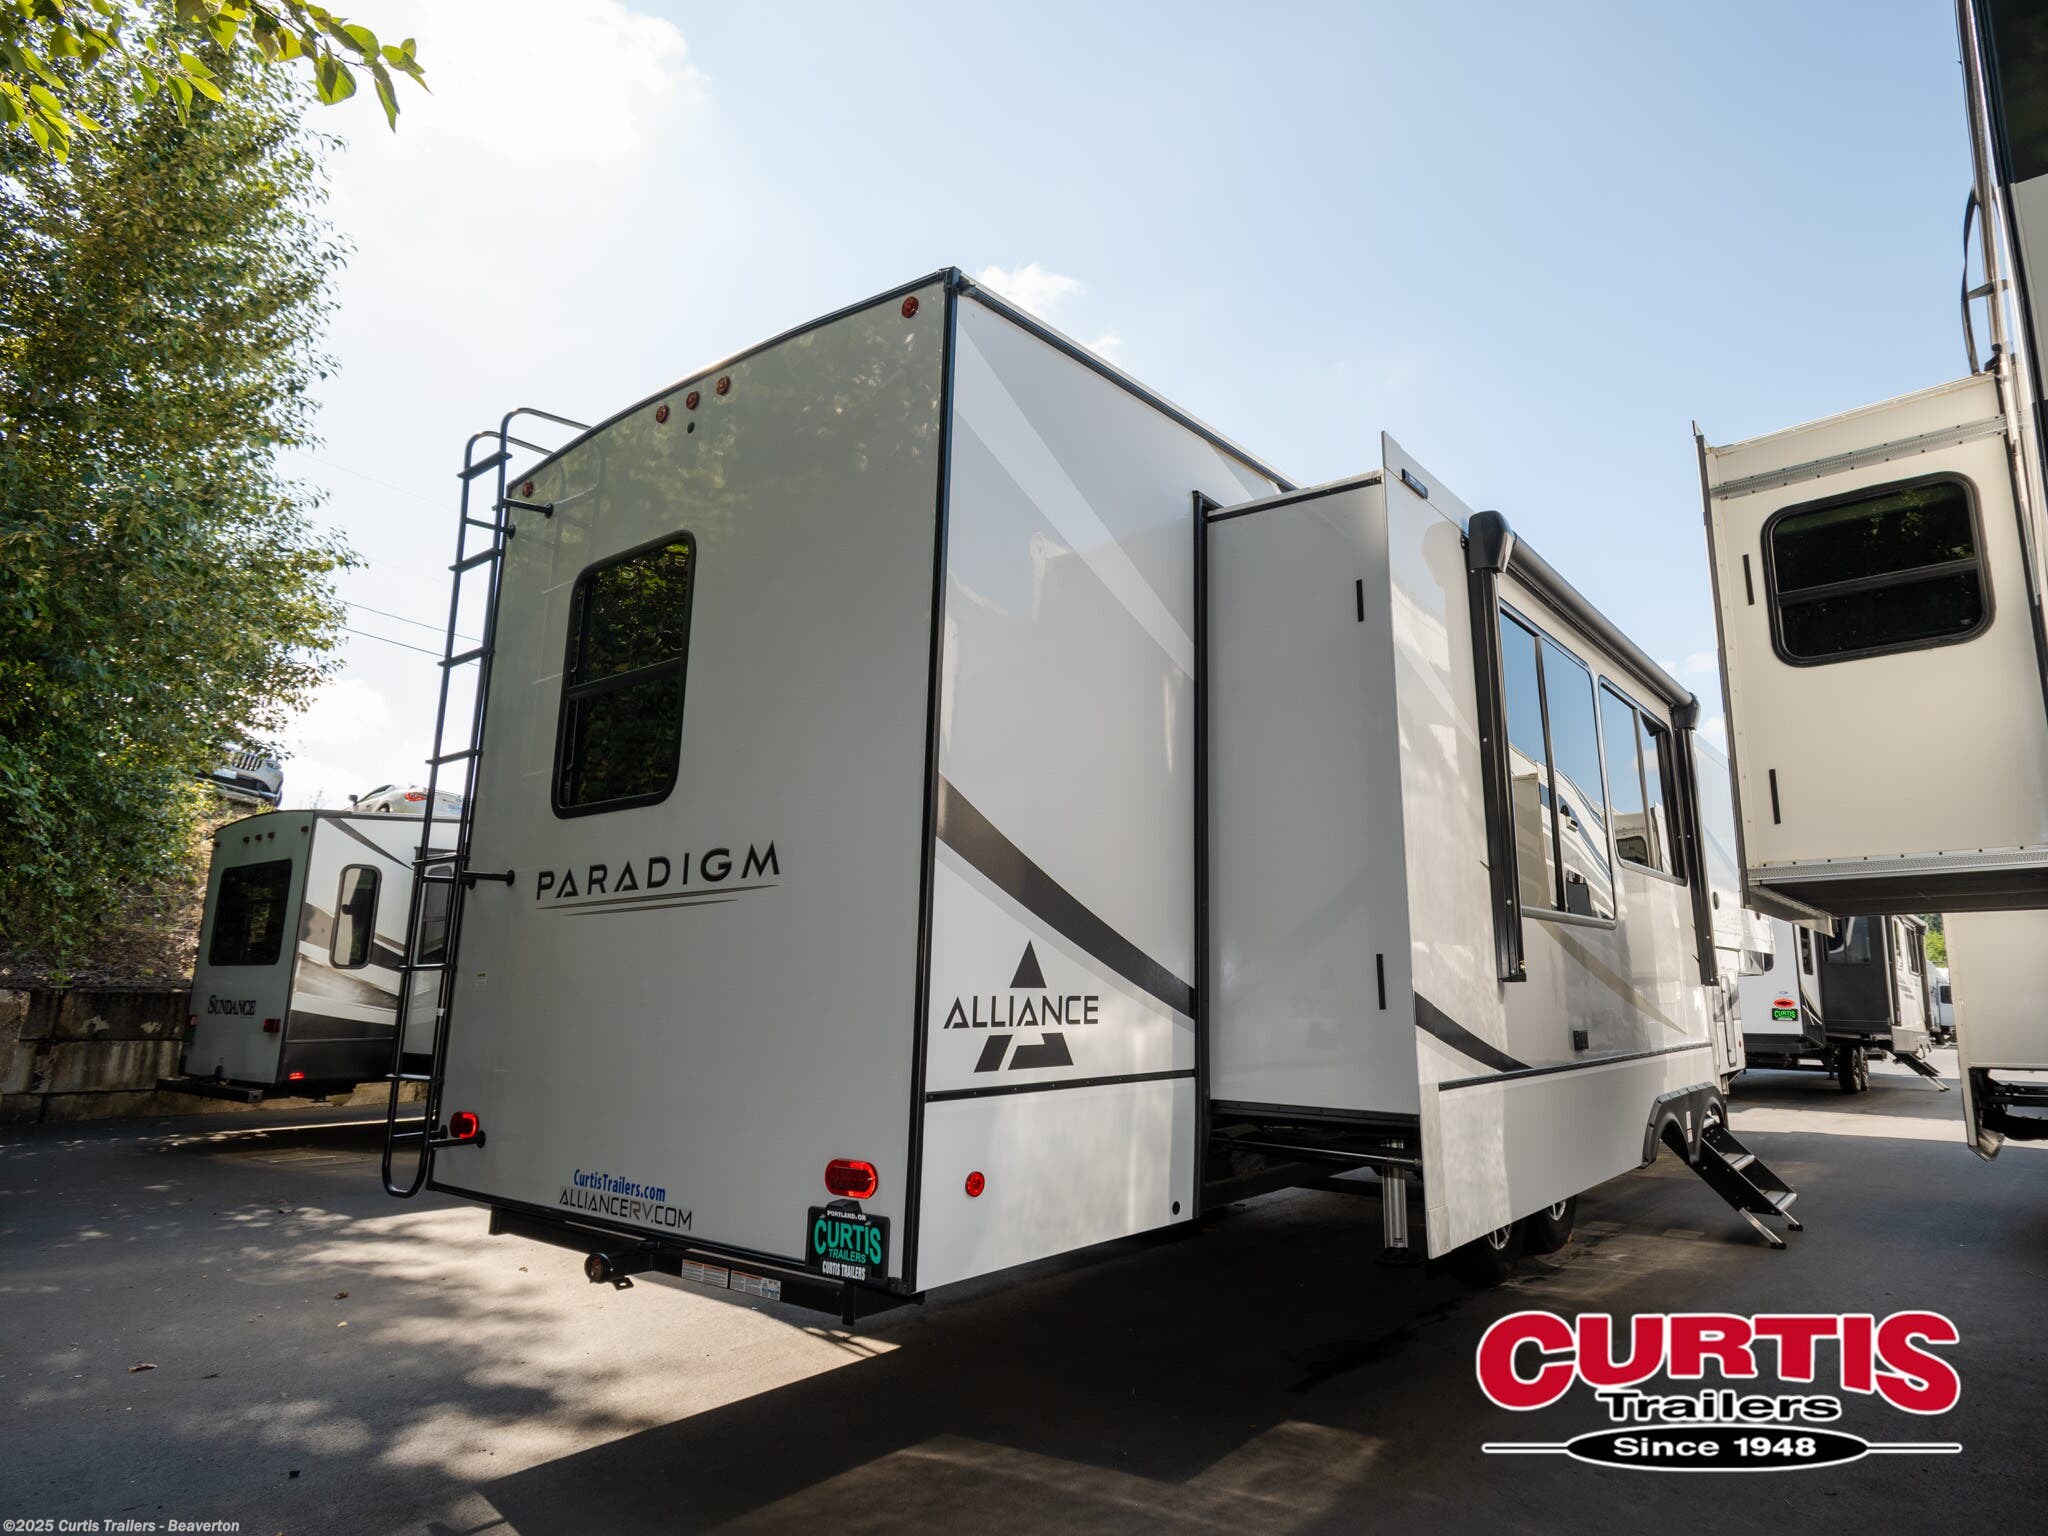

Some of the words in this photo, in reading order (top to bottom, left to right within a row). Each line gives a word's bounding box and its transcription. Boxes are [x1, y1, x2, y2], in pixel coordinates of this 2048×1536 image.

[536, 840, 780, 900] PARADIGM
[943, 995, 1099, 1029] ALLIANCE
[573, 1169, 666, 1202] CurtisTrailers.com
[559, 1189, 693, 1231] ALLIANCERV.COM
[814, 1219, 881, 1265] CURTIS
[828, 1248, 867, 1264] TRAILERS
[822, 1260, 841, 1277] CURTIS
[841, 1263, 866, 1281] TRAILERS
